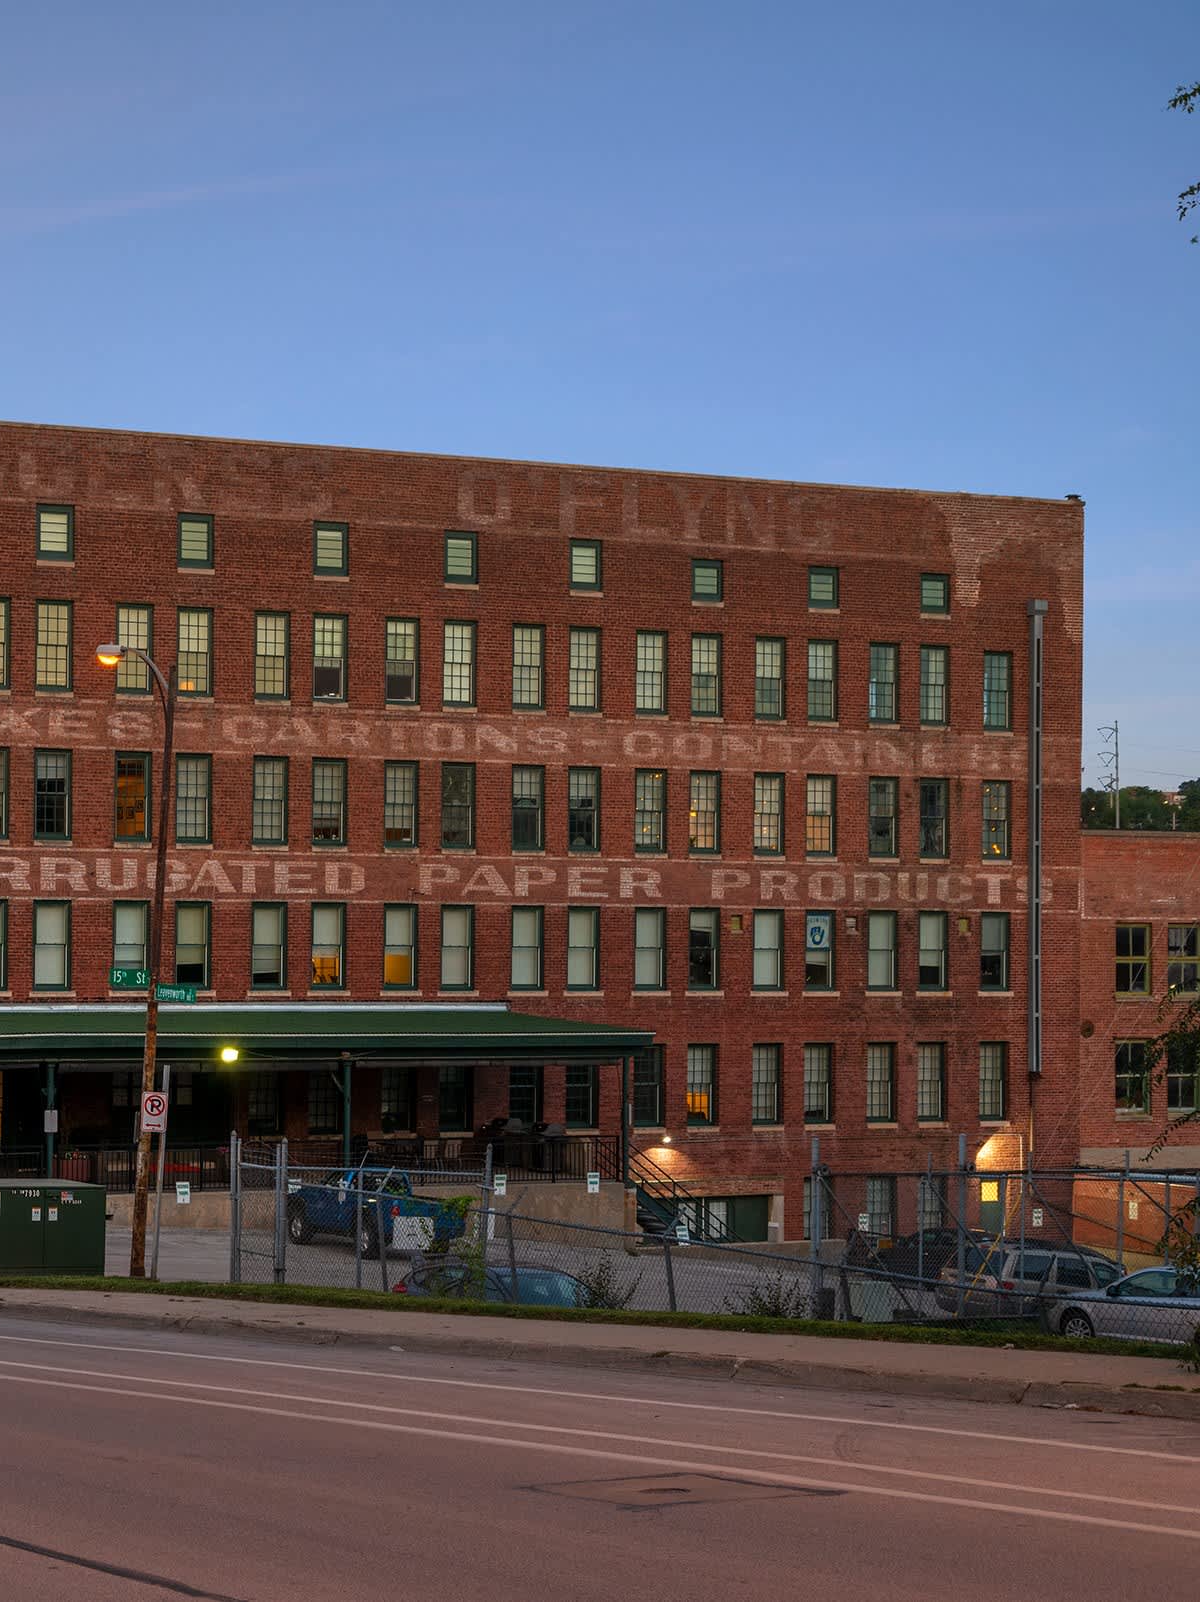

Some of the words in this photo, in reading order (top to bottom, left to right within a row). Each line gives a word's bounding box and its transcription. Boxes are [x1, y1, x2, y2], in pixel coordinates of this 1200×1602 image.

[221, 716, 567, 752] CARTONS
[418, 863, 662, 899] PAPER
[711, 868, 1052, 904] PRODUCTS
[136, 971, 146, 985] St
